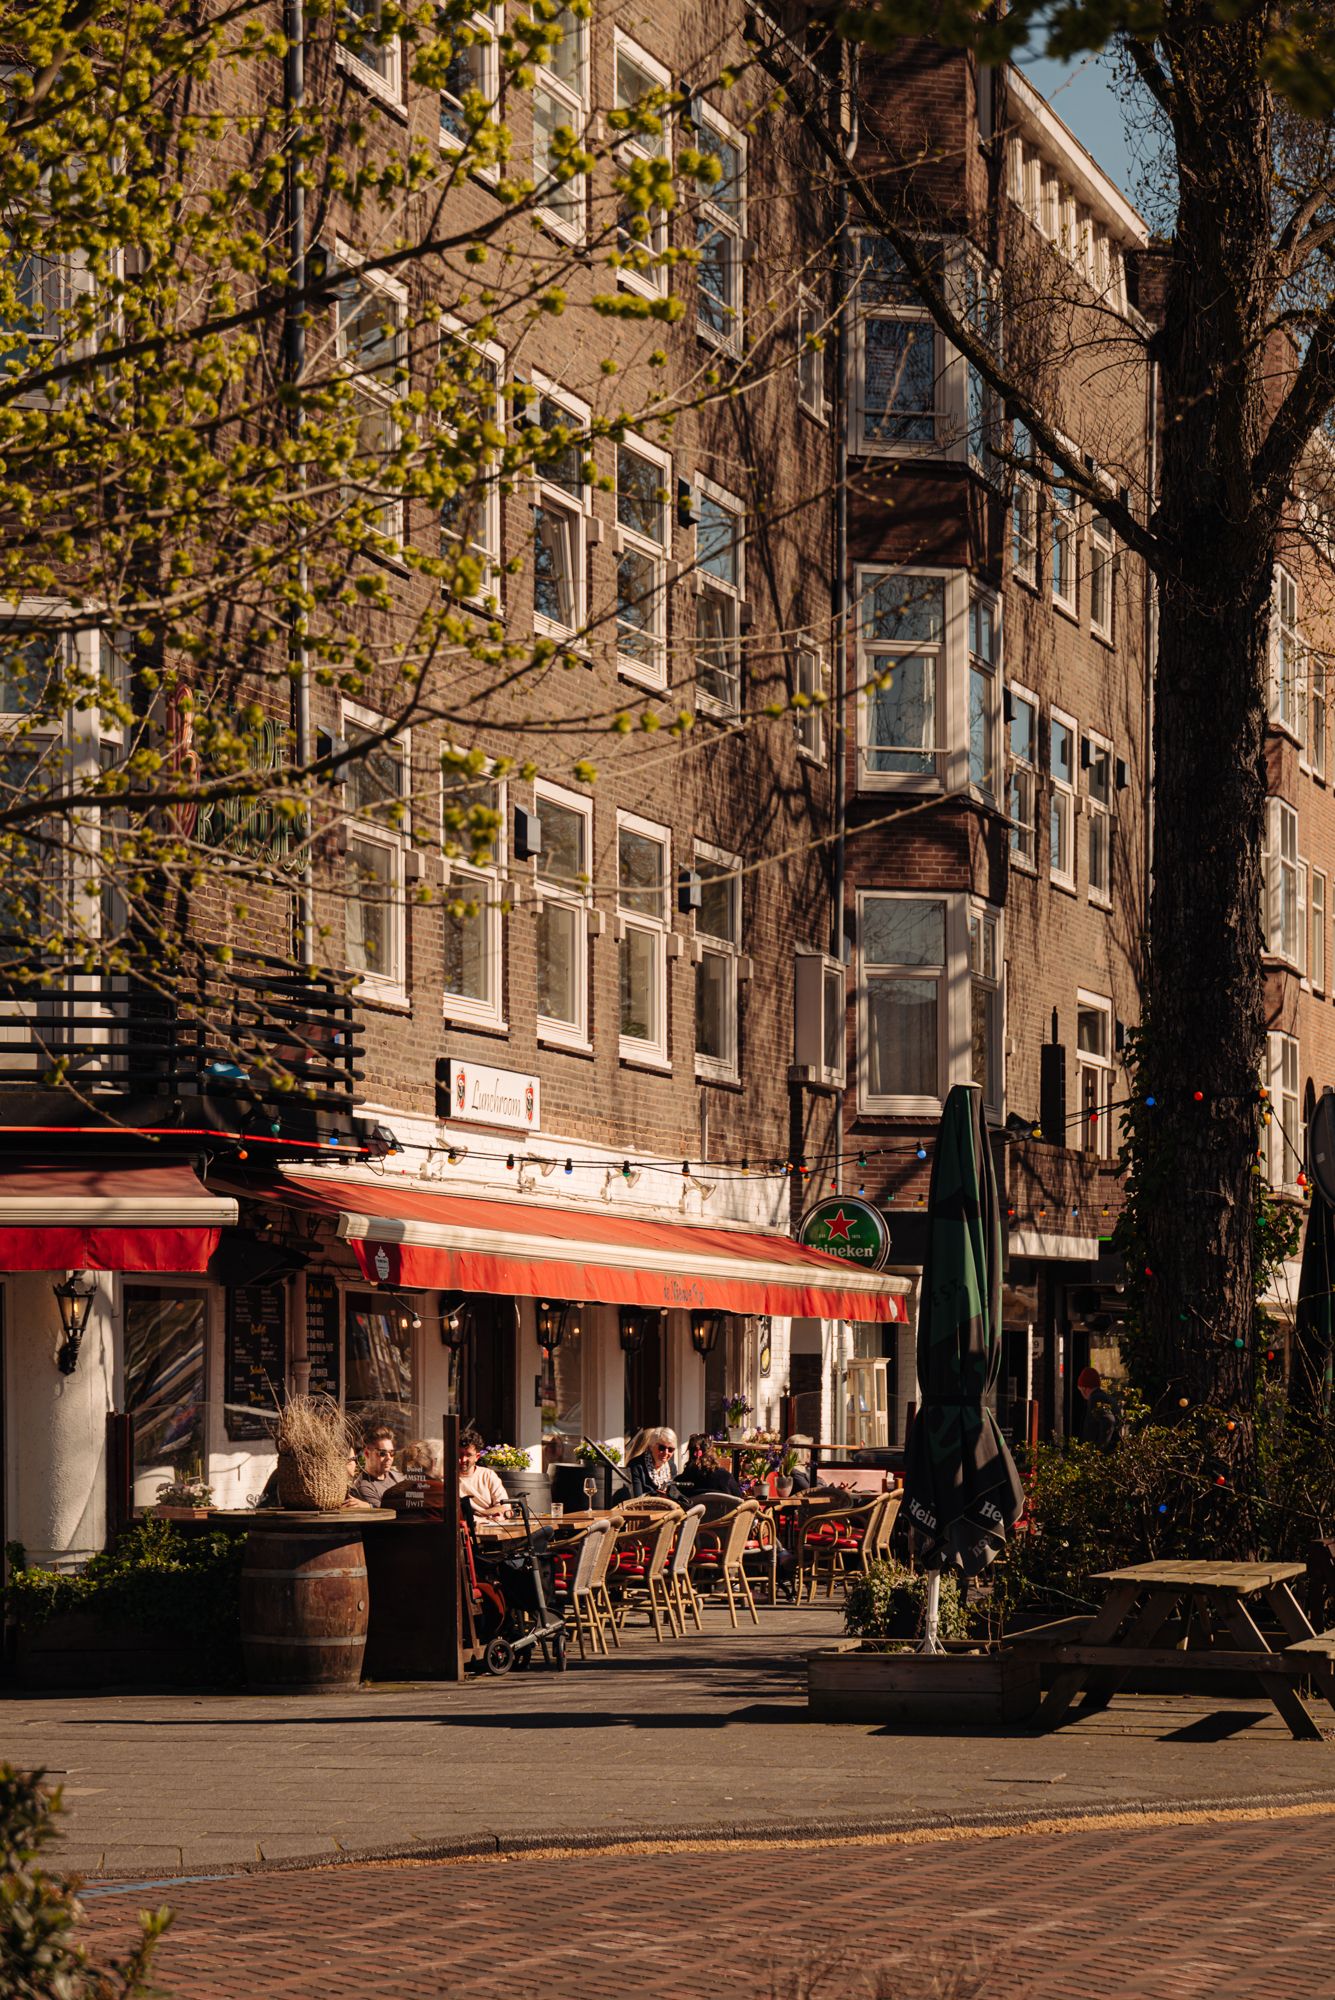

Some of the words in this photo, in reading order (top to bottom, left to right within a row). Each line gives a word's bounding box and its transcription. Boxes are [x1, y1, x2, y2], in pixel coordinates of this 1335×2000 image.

[472, 1078, 521, 1118] Lunchroom
[809, 1243, 873, 1257] ineken
[909, 1498, 937, 1529] Hein
